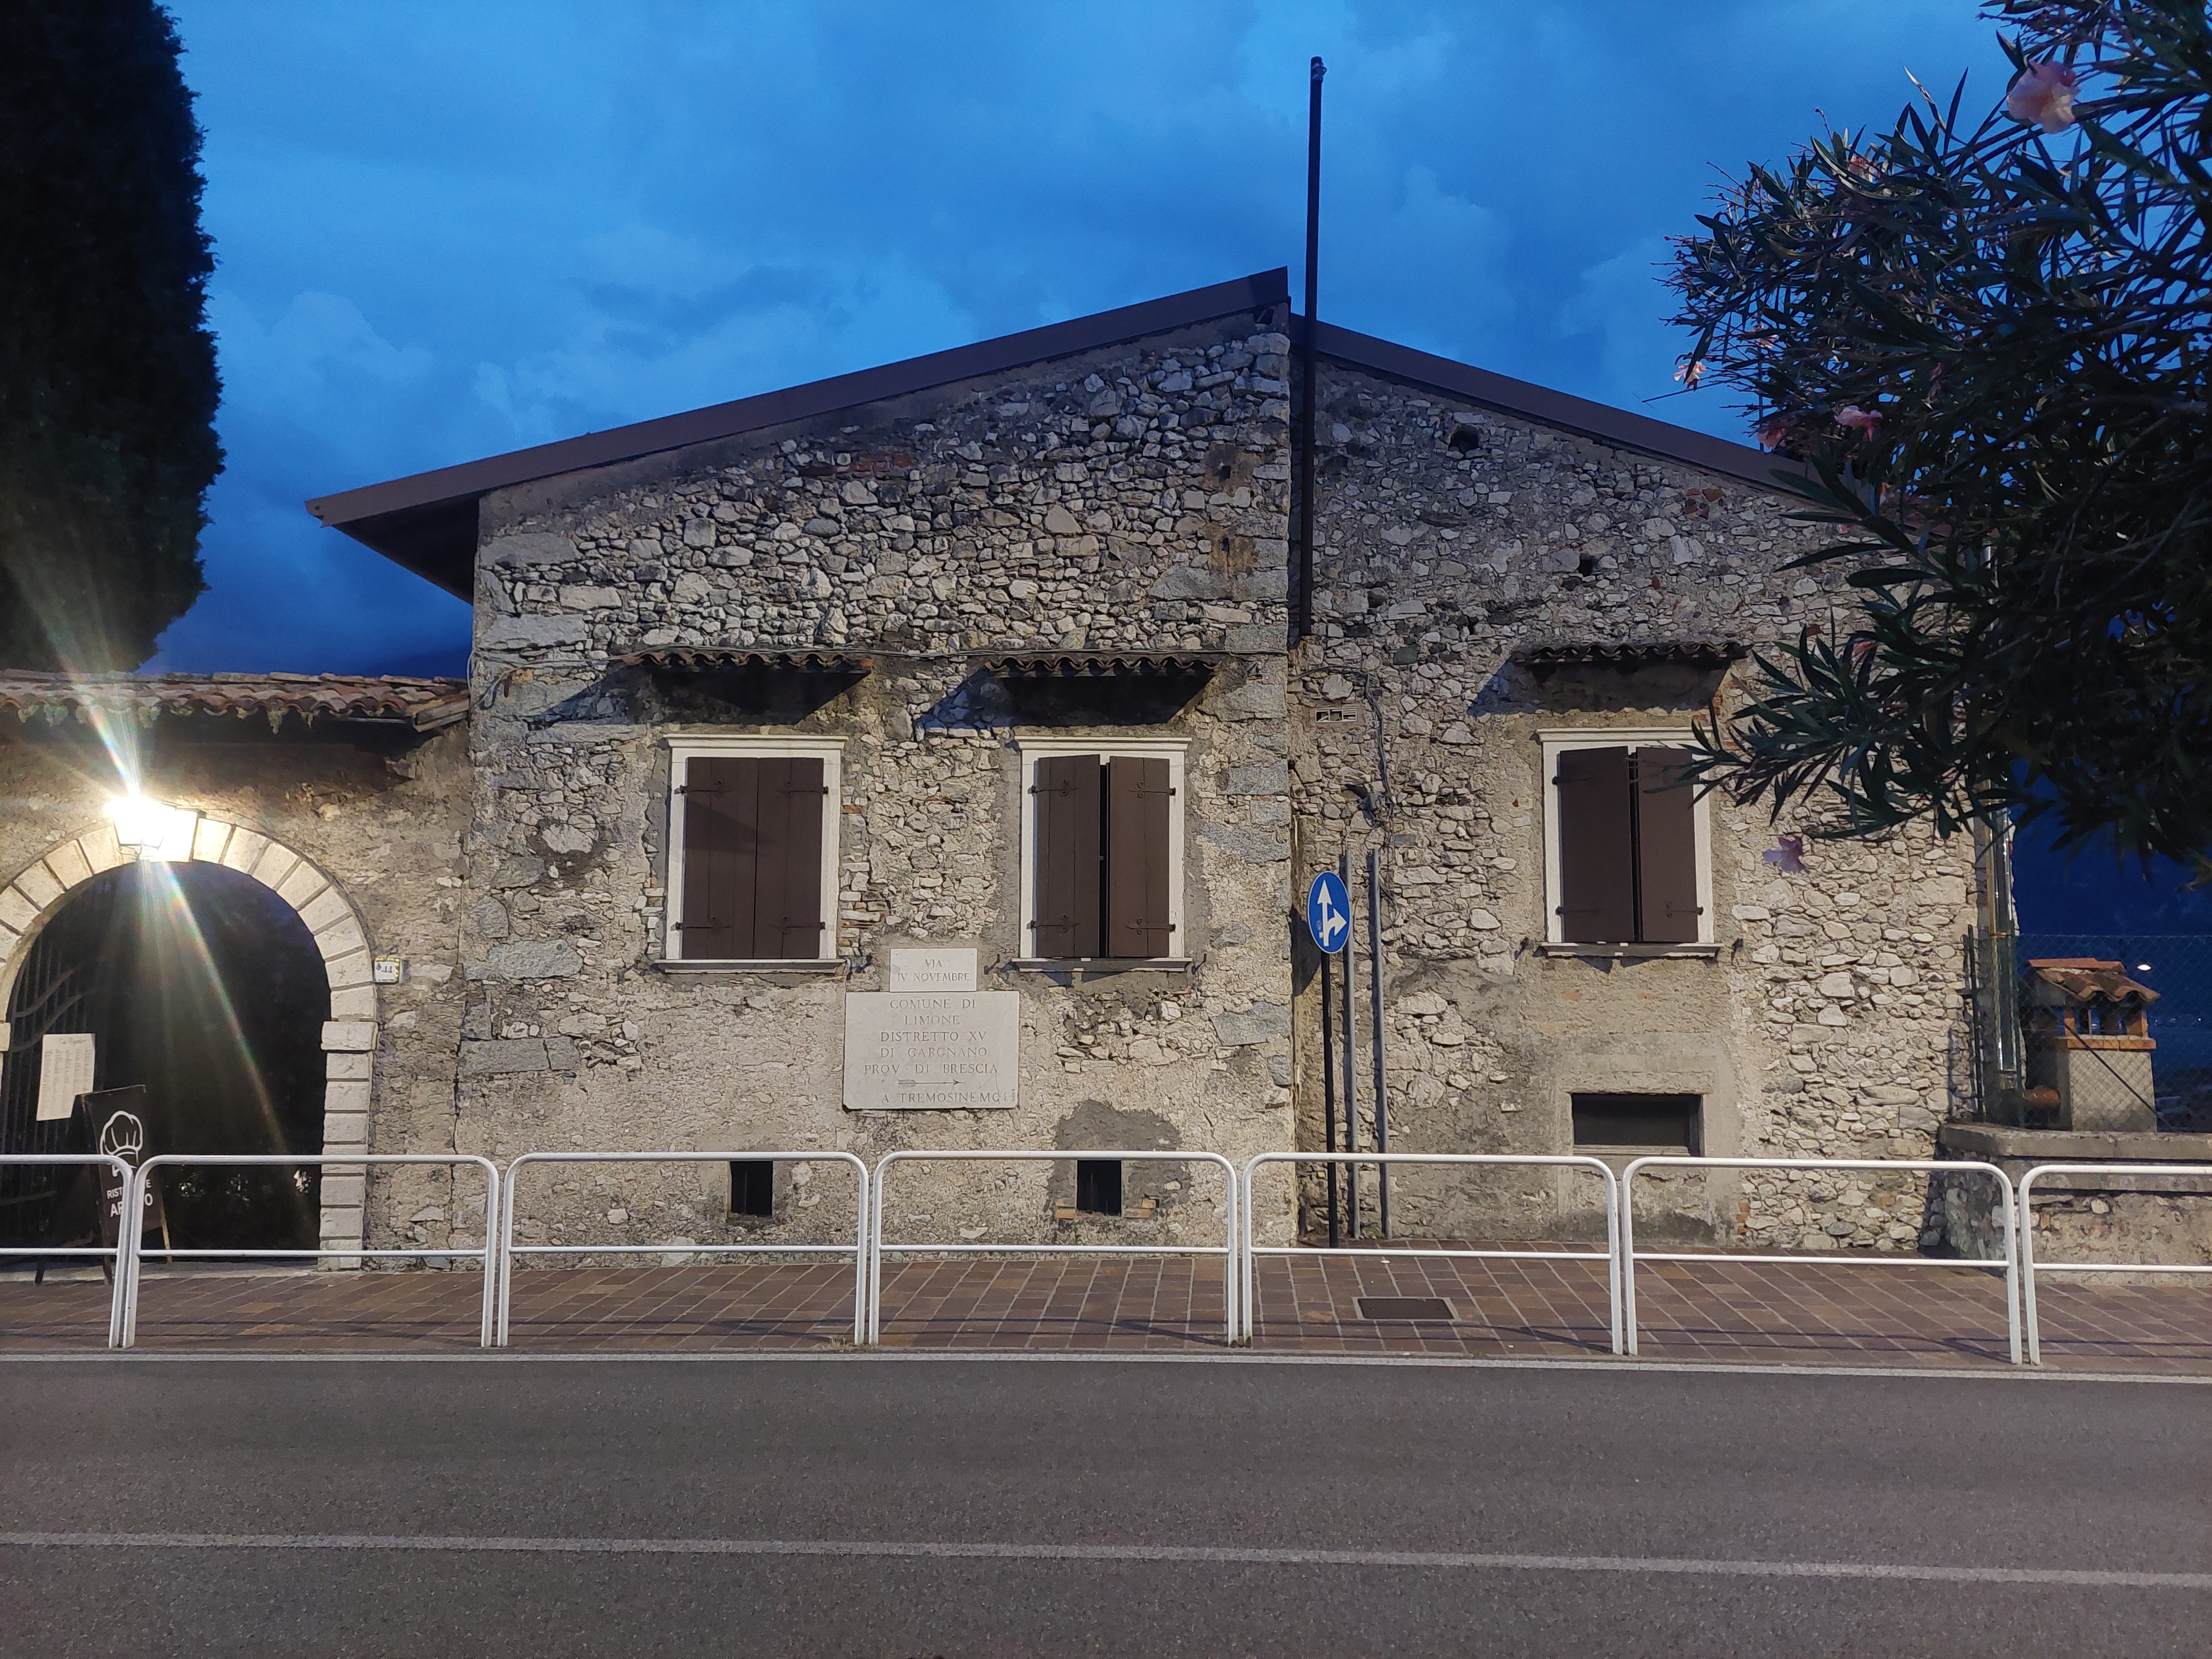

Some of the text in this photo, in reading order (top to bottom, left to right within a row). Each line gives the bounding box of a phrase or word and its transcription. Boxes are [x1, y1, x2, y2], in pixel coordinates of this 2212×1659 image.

[925, 959, 942, 968] VIA
[897, 972, 970, 981] IV NOVEMBRE
[890, 999, 975, 1009] COMUNE DI
[904, 1015, 960, 1025] LIMONE
[880, 1031, 987, 1042] DISTRETTO XV
[880, 1047, 987, 1058] DI GARGNANO
[915, 1064, 929, 1074] DI
[943, 1063, 997, 1074] BRESCIA
[883, 1094, 889, 1103] A
[898, 1093, 976, 1103] TREMOSINE
